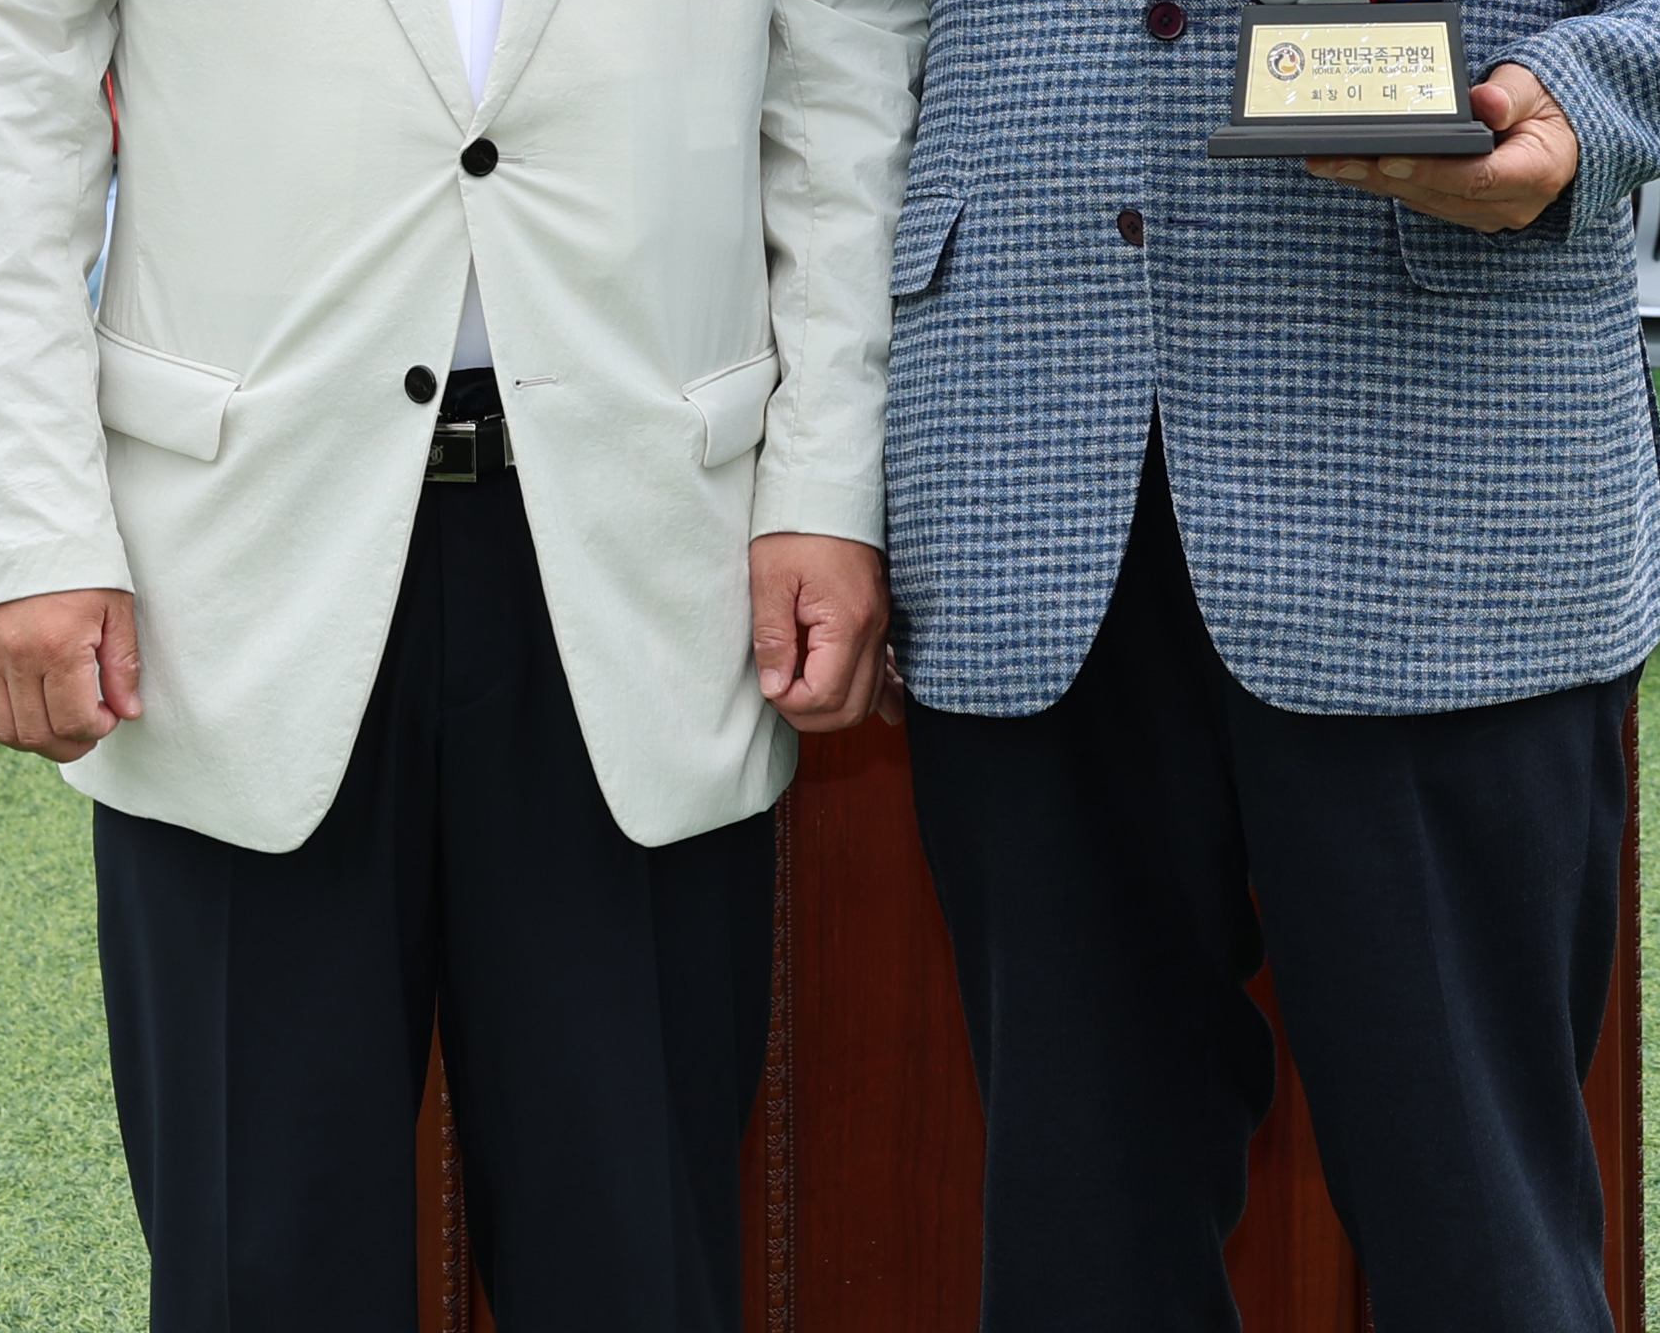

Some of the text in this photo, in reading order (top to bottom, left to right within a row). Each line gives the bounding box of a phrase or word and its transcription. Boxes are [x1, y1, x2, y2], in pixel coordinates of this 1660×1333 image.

[1310, 45, 1435, 66] 대한민국족구협회
[1344, 65, 1374, 75] OKGU
[1377, 64, 1435, 75] ASSOCIATON
